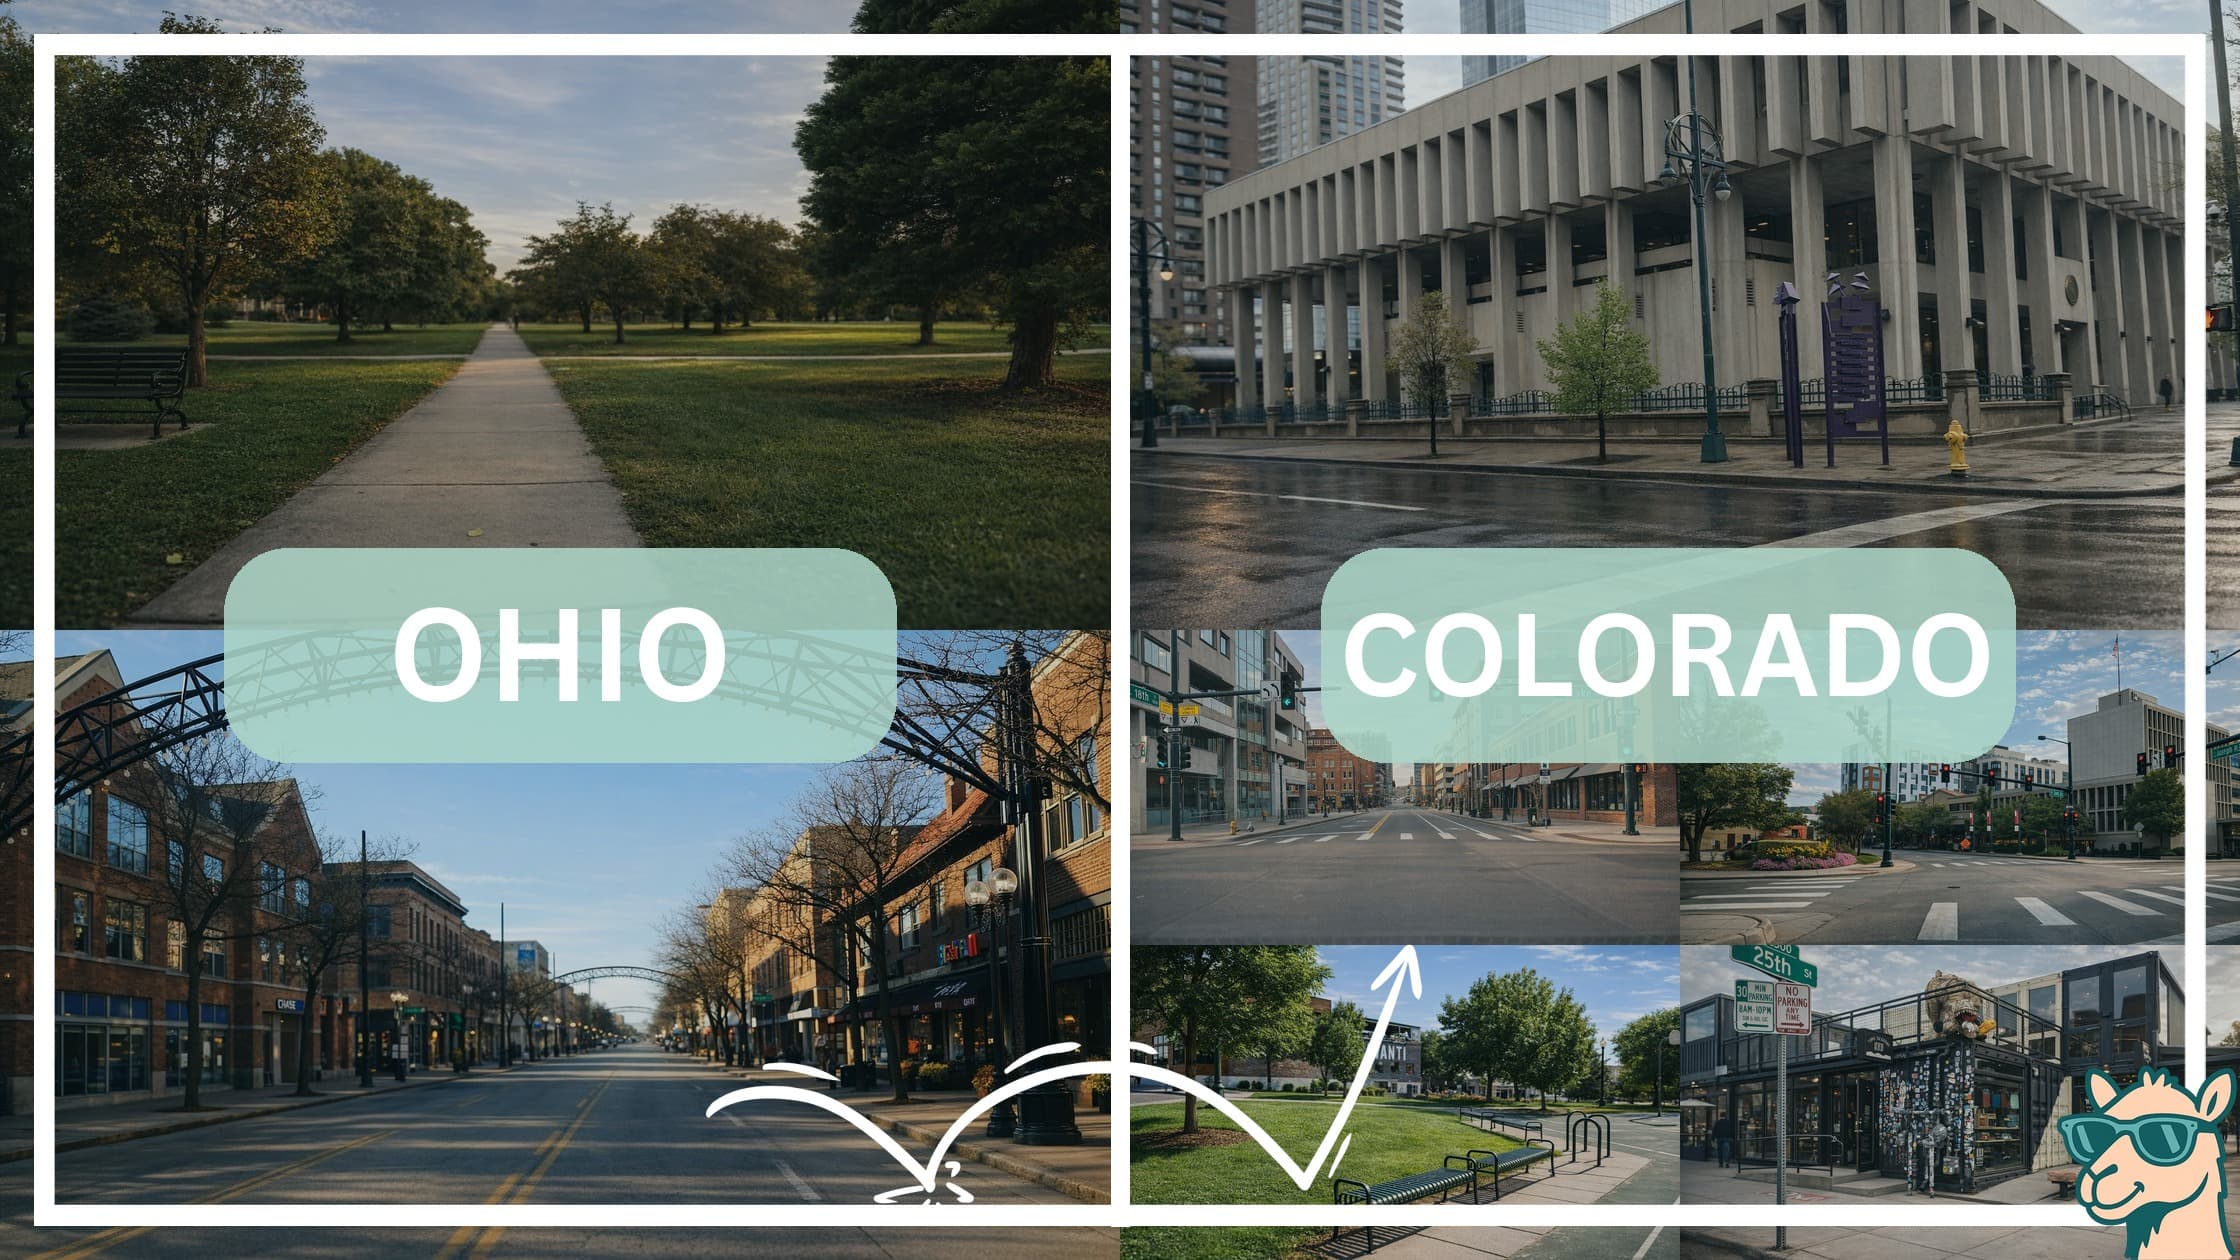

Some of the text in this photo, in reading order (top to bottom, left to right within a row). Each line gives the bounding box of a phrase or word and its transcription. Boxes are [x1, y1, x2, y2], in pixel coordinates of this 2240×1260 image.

[1753, 946, 1812, 979] 25th St
[1736, 983, 1767, 998] 30 MIN
[1785, 986, 1799, 997] NO
[1749, 992, 1773, 1002] PARKING
[1777, 996, 1808, 1008] PARKING
[277, 998, 297, 1010] CHASE
[1785, 1007, 1800, 1015] ANY
[1785, 1013, 1800, 1021] TIME
